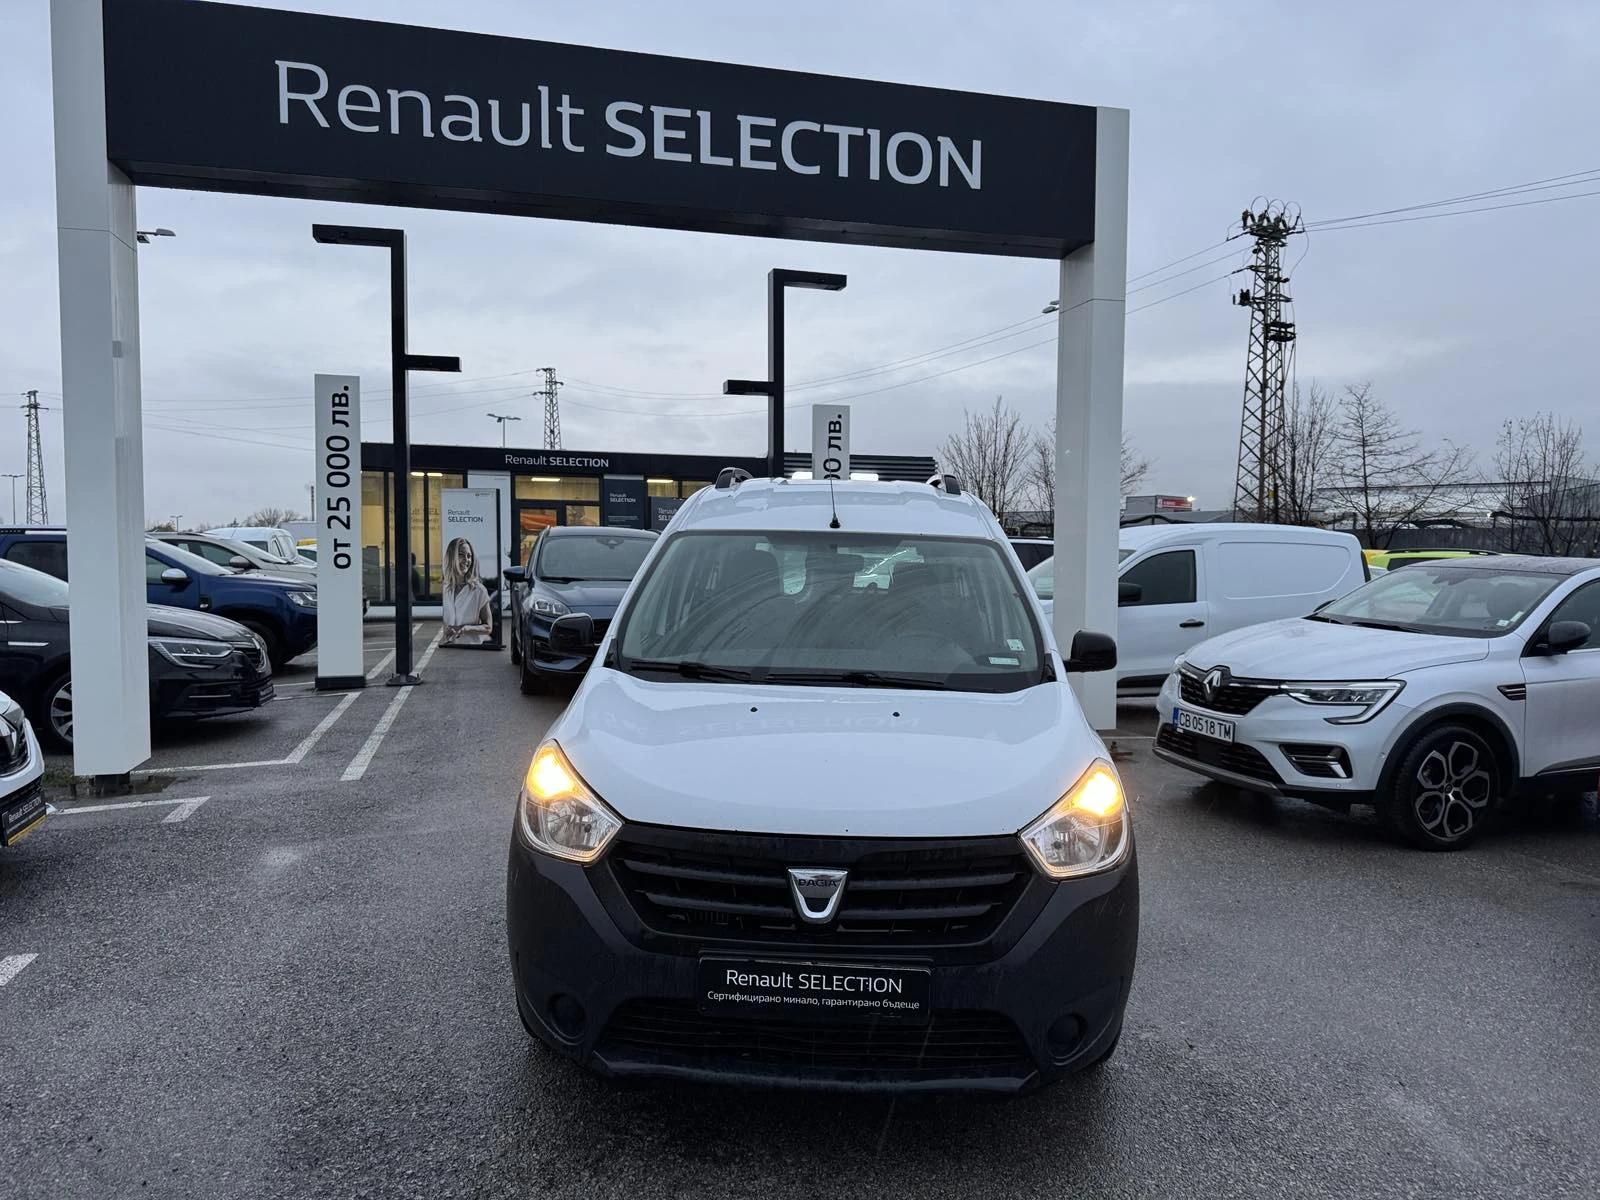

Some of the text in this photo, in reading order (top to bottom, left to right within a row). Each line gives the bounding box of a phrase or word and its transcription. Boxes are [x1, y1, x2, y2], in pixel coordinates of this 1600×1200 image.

[274, 60, 983, 191] Renault SELECTION
[828, 414, 841, 451] лв.
[505, 454, 609, 468] Renault SELECTION
[326, 385, 351, 569] от 25 000 лв.
[447, 508, 471, 516] Renault
[1180, 712, 1231, 739] CB 0518 TM
[798, 879, 837, 888] DACIA
[726, 969, 902, 994] Renault SELECTION
[707, 990, 920, 1009] Сертифицирано минало, гарантирано бъдеще
